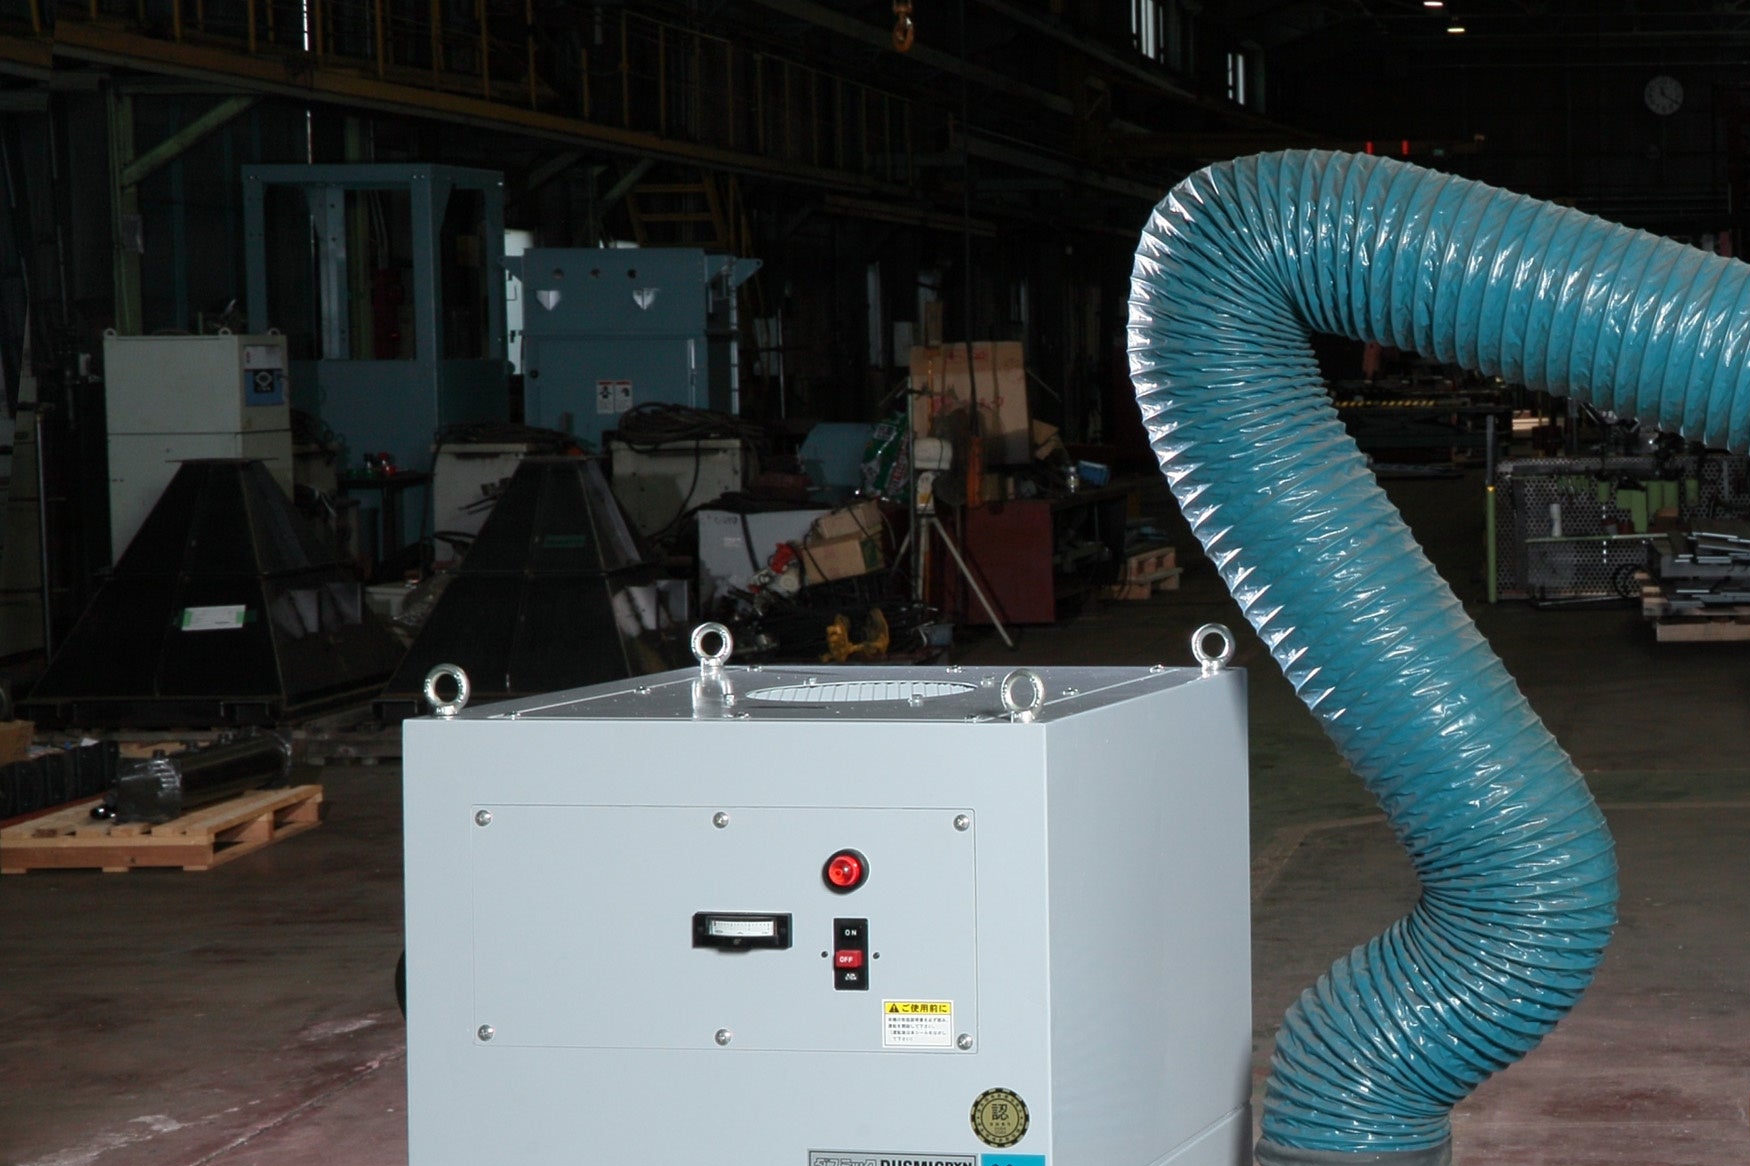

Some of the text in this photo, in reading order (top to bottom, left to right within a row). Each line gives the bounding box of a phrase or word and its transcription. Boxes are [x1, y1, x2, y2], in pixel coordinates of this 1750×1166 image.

[839, 955, 853, 963] OFF
[902, 1003, 948, 1013] ご使用前に
